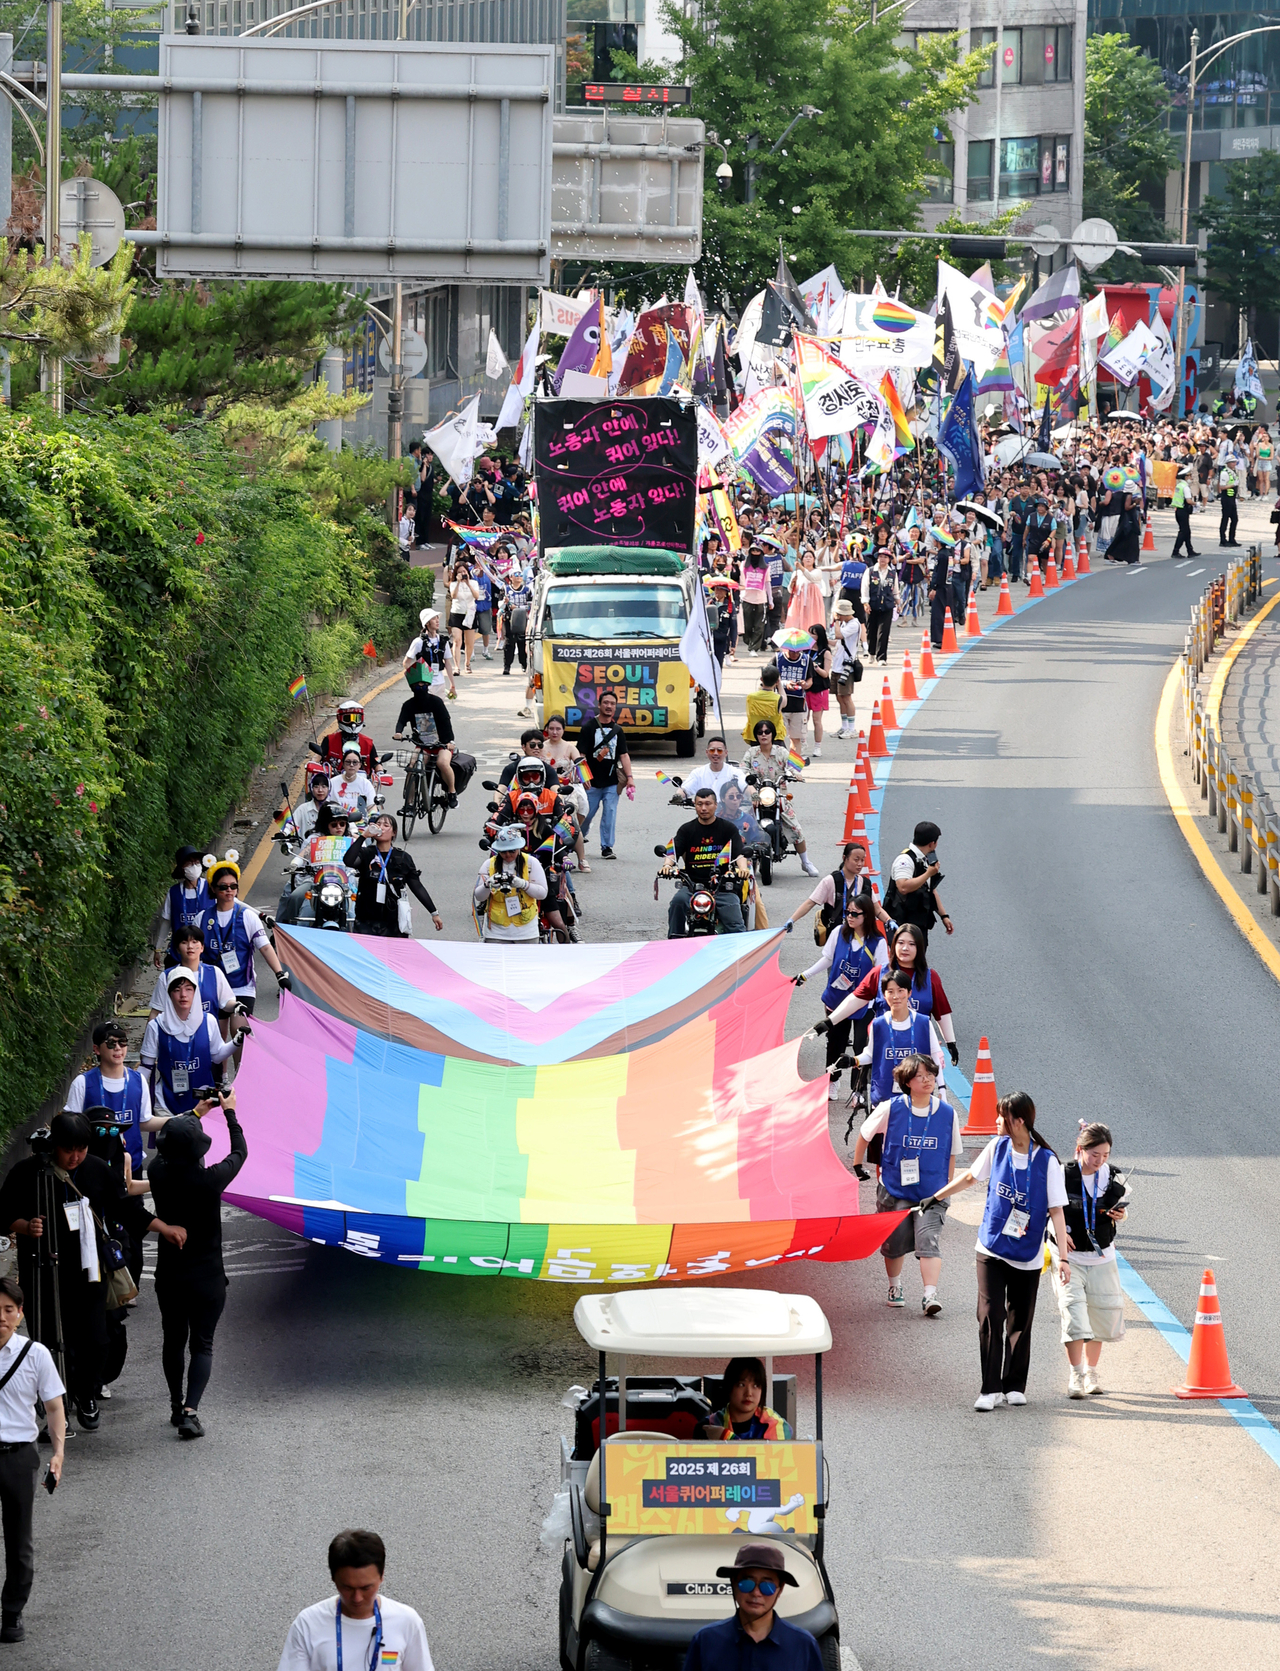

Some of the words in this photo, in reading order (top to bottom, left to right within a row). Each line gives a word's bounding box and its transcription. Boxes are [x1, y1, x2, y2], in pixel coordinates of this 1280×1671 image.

[548, 425, 600, 458] 노동자
[602, 413, 639, 437] 안에
[605, 439, 641, 464] 퀴어
[641, 428, 681, 453] 있다!
[556, 487, 591, 514] 퀴어
[591, 476, 628, 499] 안에
[593, 492, 646, 524] 노동자
[647, 482, 687, 505] 있다!
[557, 648, 582, 658] 2025
[583, 648, 612, 659] 제26회
[614, 647, 680, 659] 서울퀴어퍼레이드
[578, 664, 655, 685] SEOUL
[566, 707, 666, 727] PAADE
[669, 1462, 705, 1476] 2025
[706, 1462, 719, 1476] 제
[721, 1462, 751, 1476] 26회
[649, 1485, 772, 1503] 서울퀴어퍼레이드
[685, 1583, 712, 1595] Club
[716, 1583, 733, 1595] Ca
